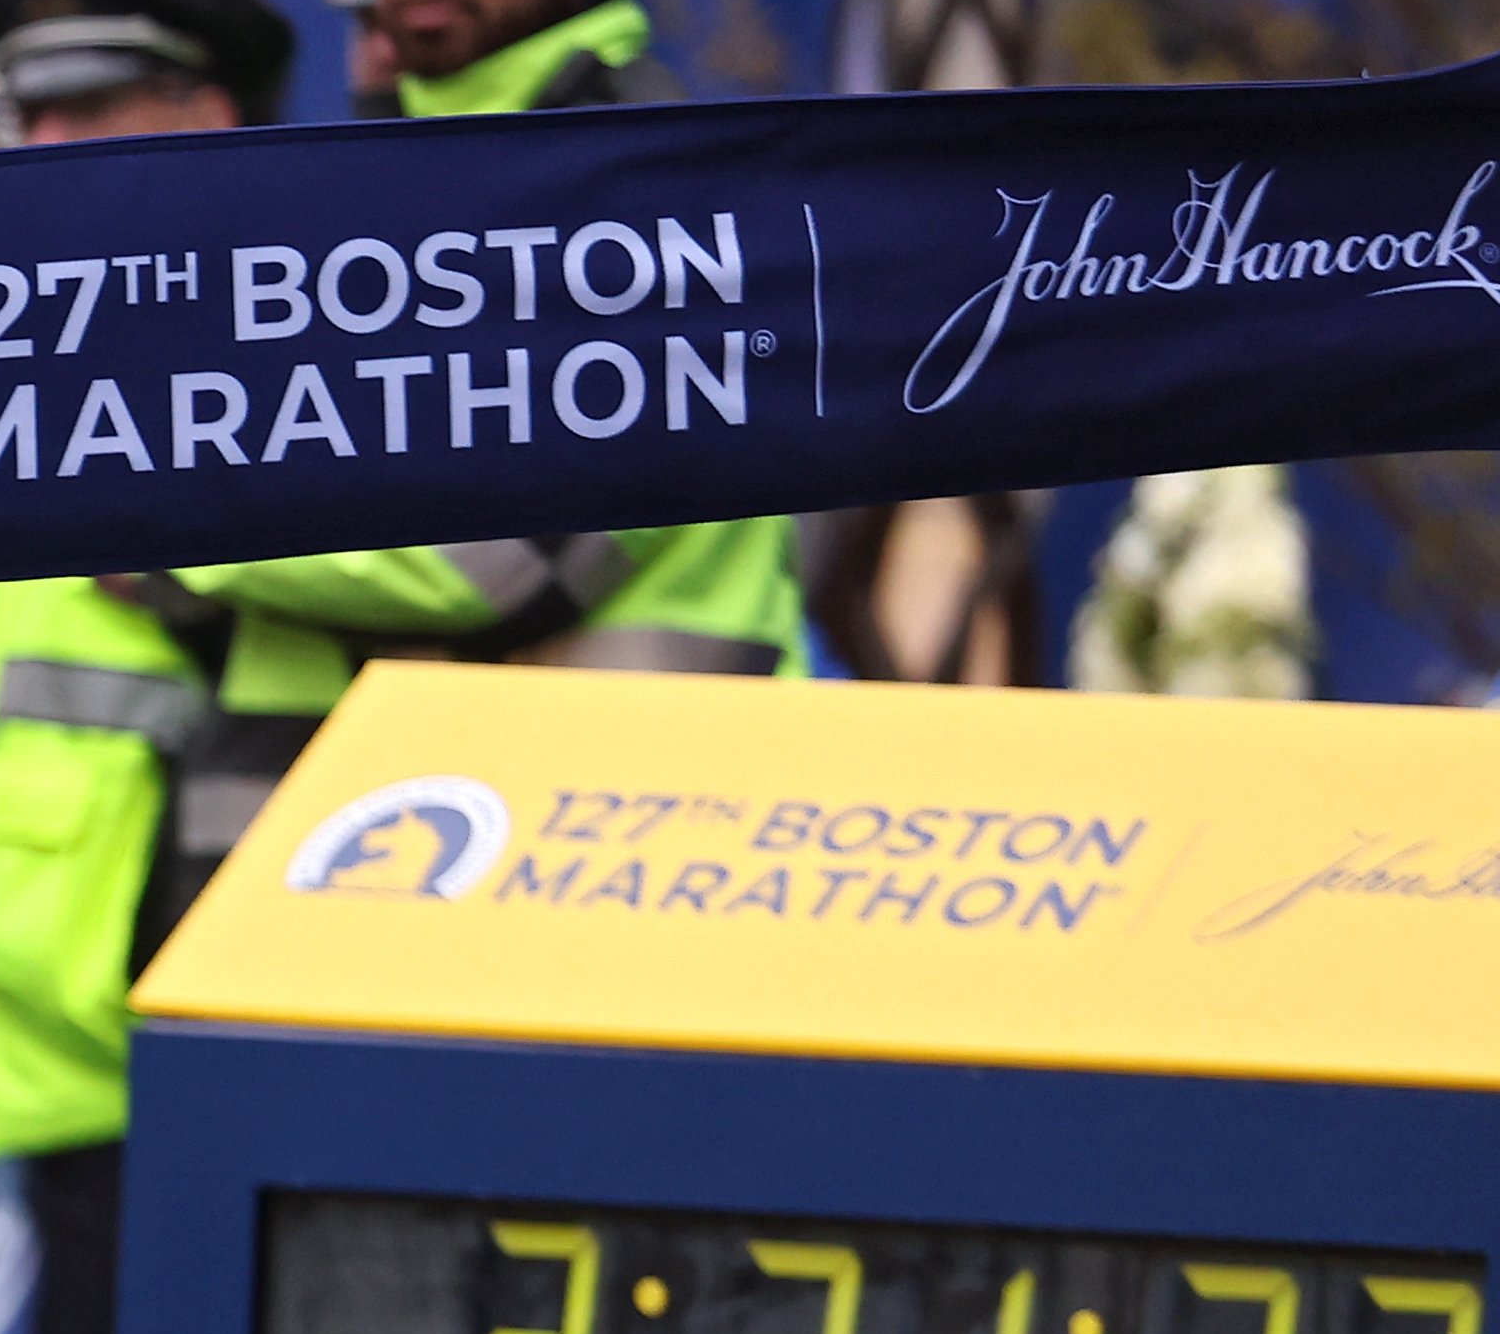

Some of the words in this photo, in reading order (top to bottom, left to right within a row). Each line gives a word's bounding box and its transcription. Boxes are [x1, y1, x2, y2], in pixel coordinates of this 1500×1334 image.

[231, 212, 745, 342] BOSTON
[903, 186, 1149, 414] John
[746, 799, 1150, 868] BOSTON
